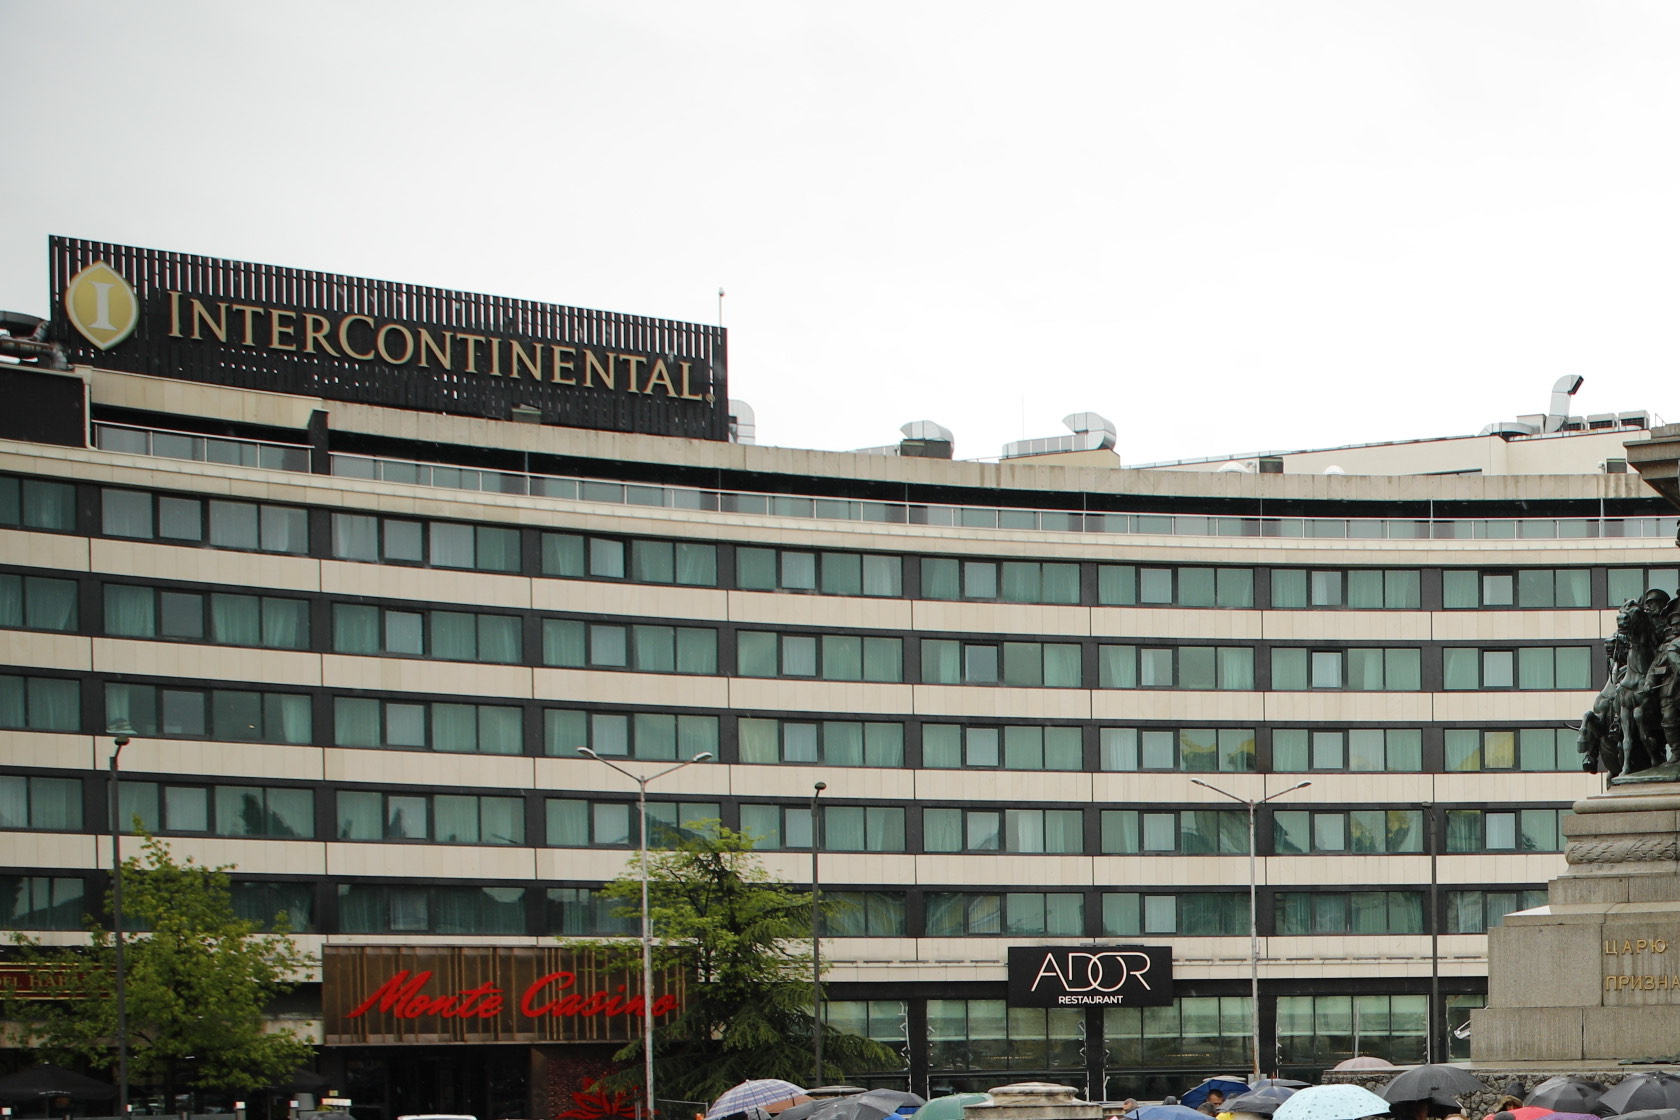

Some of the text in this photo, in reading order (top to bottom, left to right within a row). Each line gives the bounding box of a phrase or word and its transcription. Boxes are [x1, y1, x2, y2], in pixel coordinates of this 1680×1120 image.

[1605, 938, 1667, 956] ЦАРЮ
[1031, 952, 1151, 992] ADOR
[346, 969, 679, 1019] Monte Casino
[1058, 995, 1124, 1005] RESTAURANT
